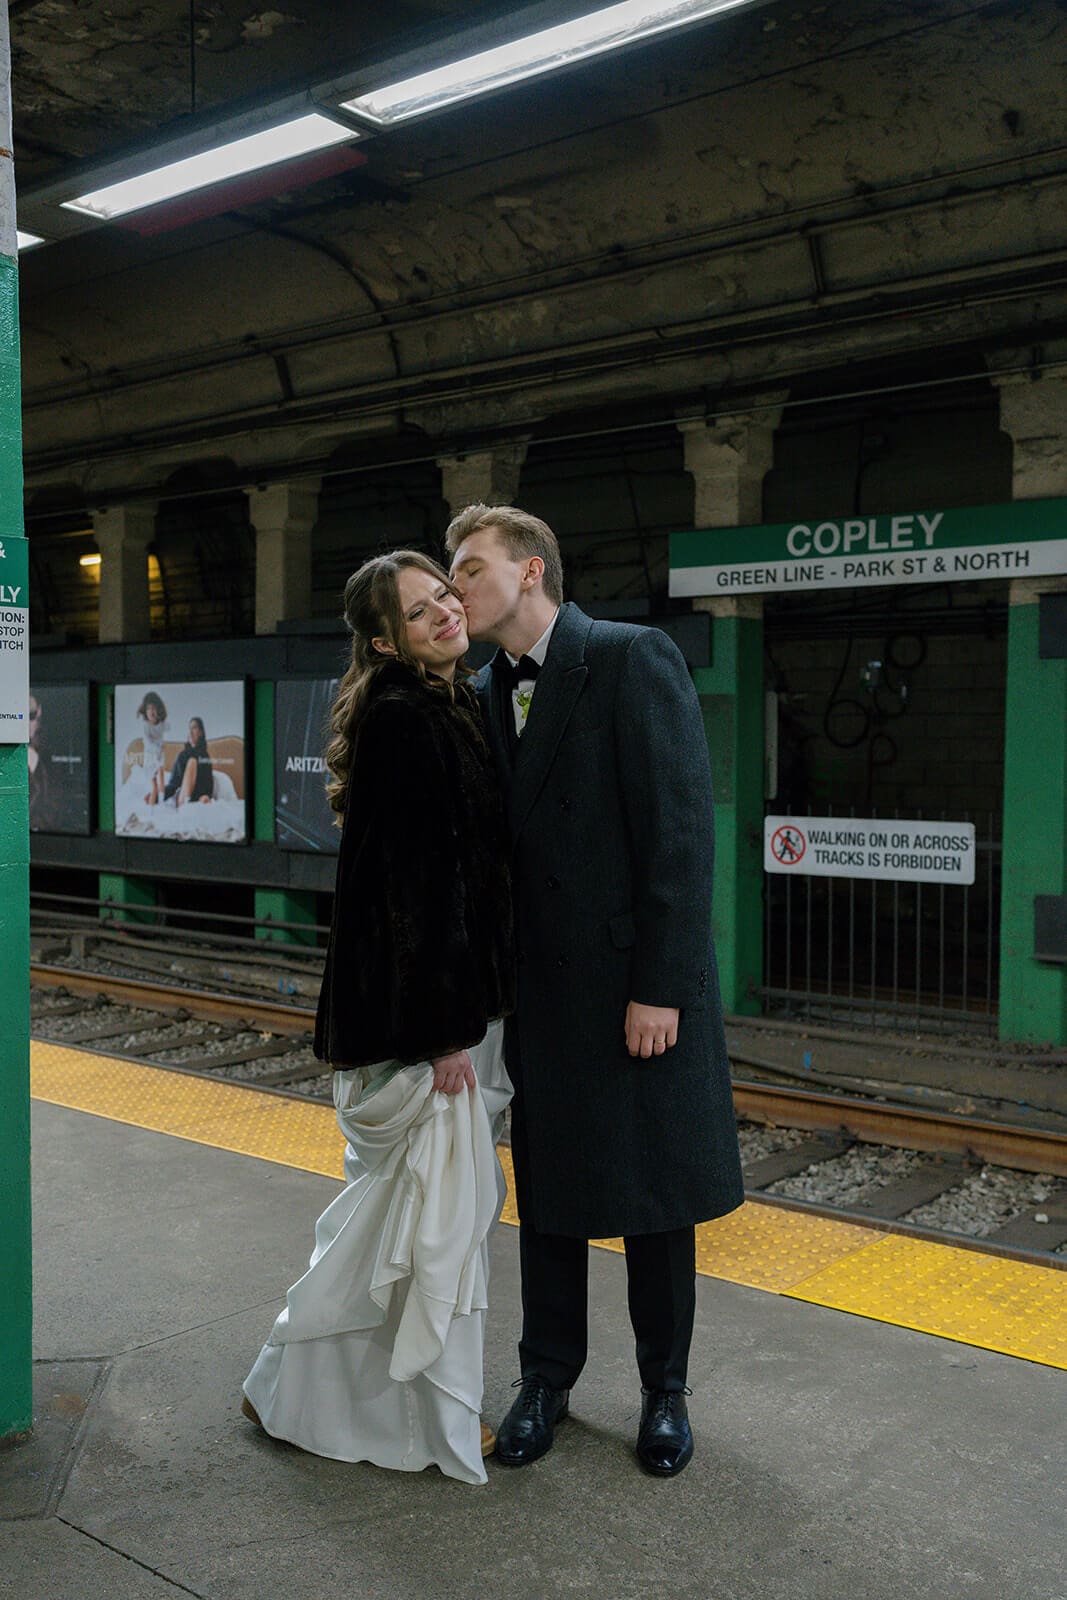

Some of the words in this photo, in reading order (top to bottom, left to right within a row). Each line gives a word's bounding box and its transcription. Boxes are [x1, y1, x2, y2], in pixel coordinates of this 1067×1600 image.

[786, 512, 945, 557] COPLEY
[716, 568, 778, 587] GREEN
[783, 565, 825, 583] LINE
[843, 560, 895, 579] PARK
[902, 557, 928, 575] ST
[933, 556, 946, 573] &
[954, 550, 1030, 572] NORTH
[285, 756, 328, 773] ARITZI
[808, 830, 865, 847] WALKING
[869, 833, 888, 848] ON
[891, 834, 909, 849] OR
[913, 836, 969, 851] ACROSS
[815, 850, 864, 866] TRACKS
[868, 853, 880, 867] IS
[884, 854, 961, 872] FORBIDDEN
